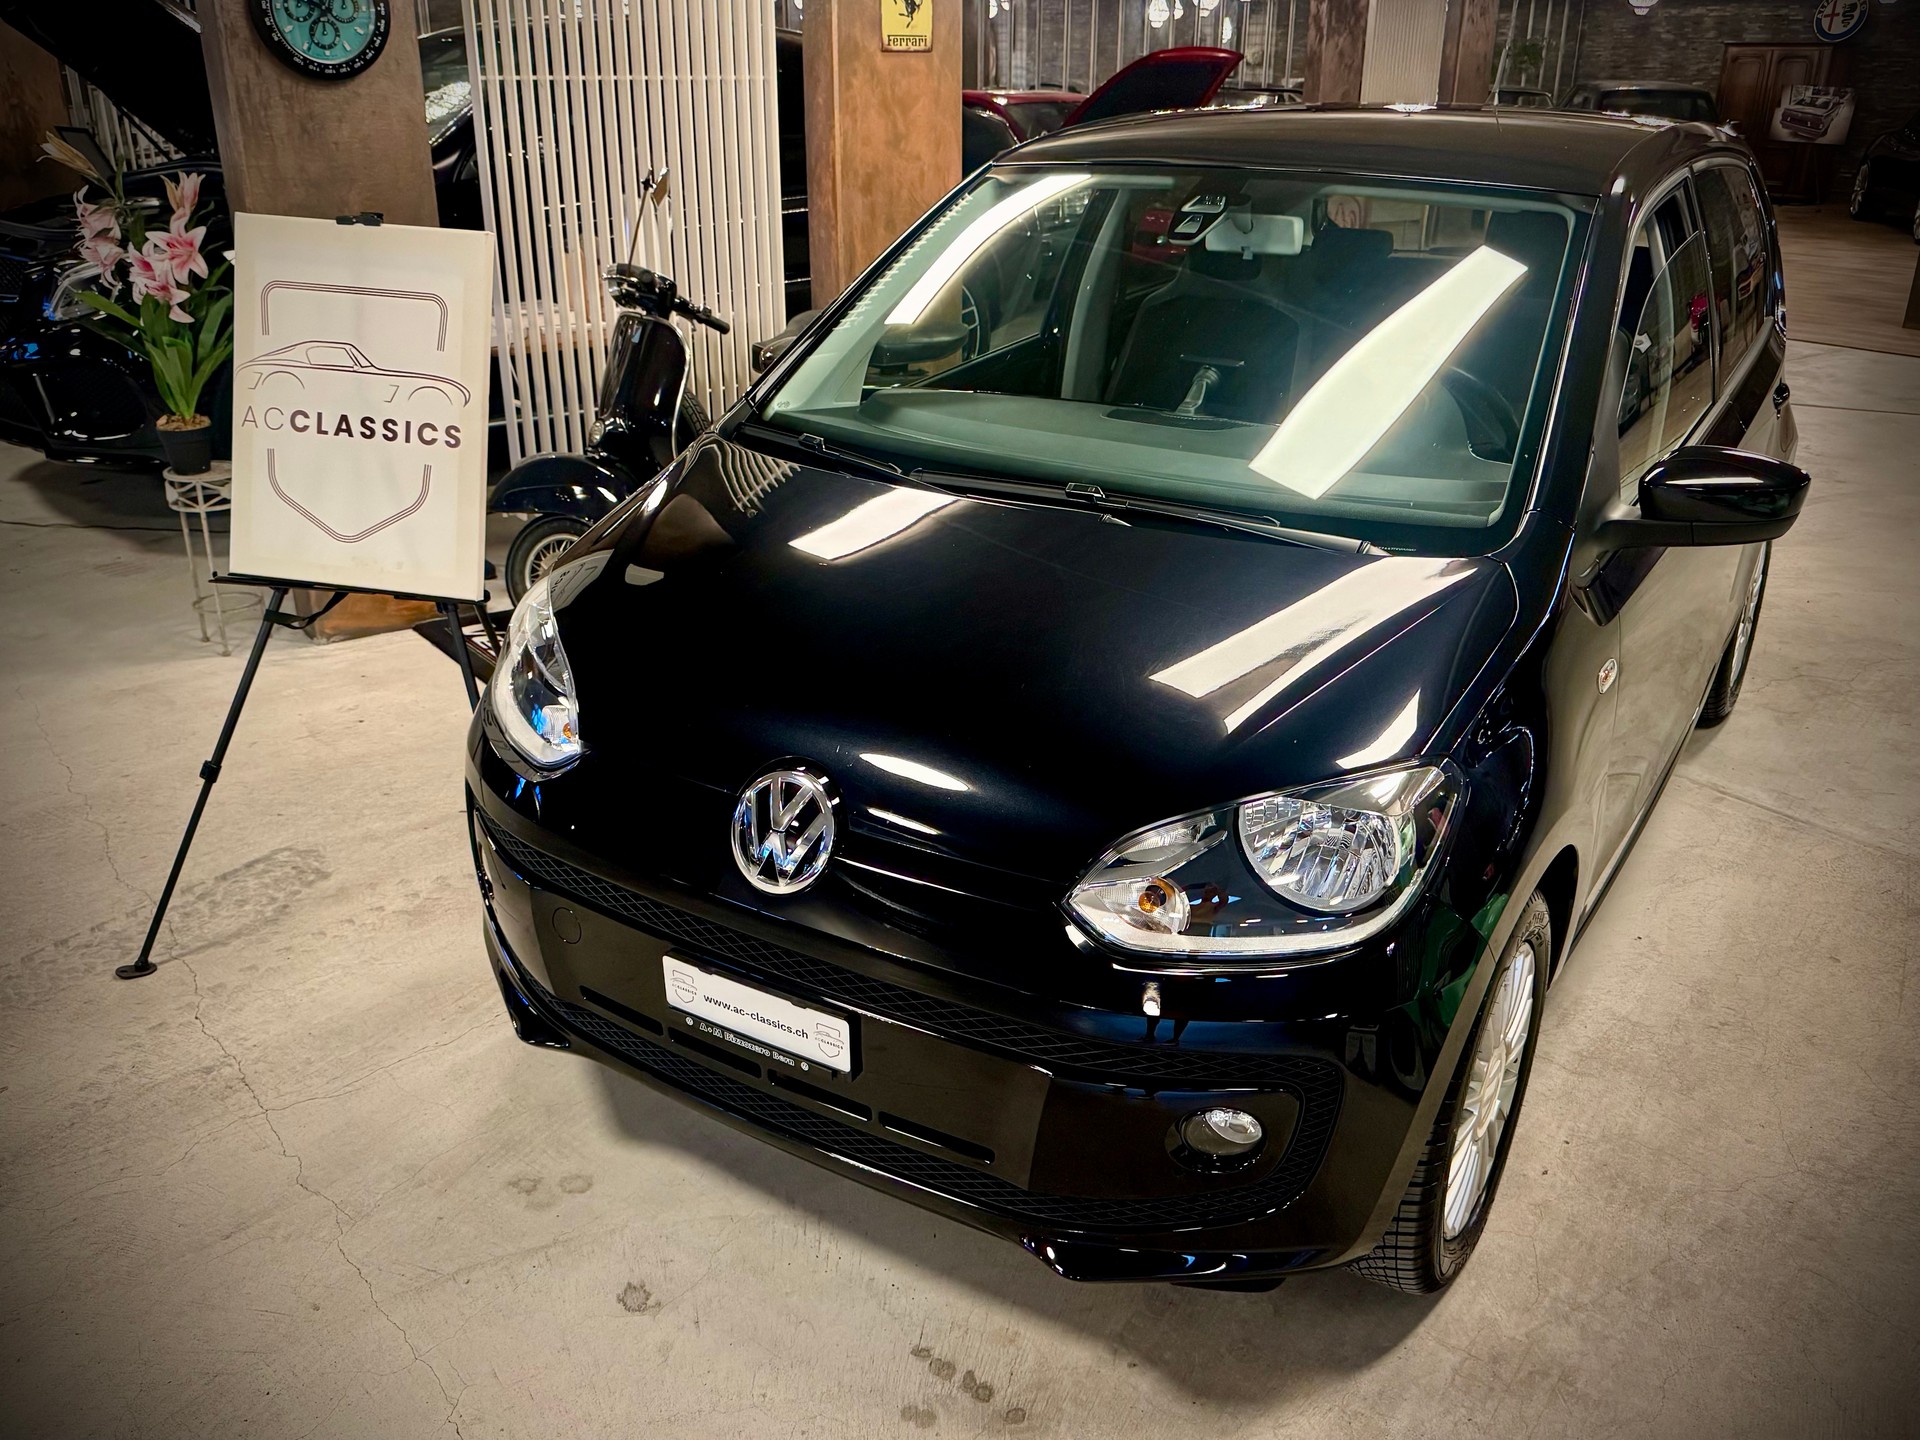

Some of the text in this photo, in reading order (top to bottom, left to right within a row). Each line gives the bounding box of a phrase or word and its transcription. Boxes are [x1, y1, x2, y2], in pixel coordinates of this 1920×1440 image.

[887, 34, 928, 47] Ferrari
[703, 993, 809, 1040] www.ac-classics.ch
[772, 1051, 795, 1067] Bern
